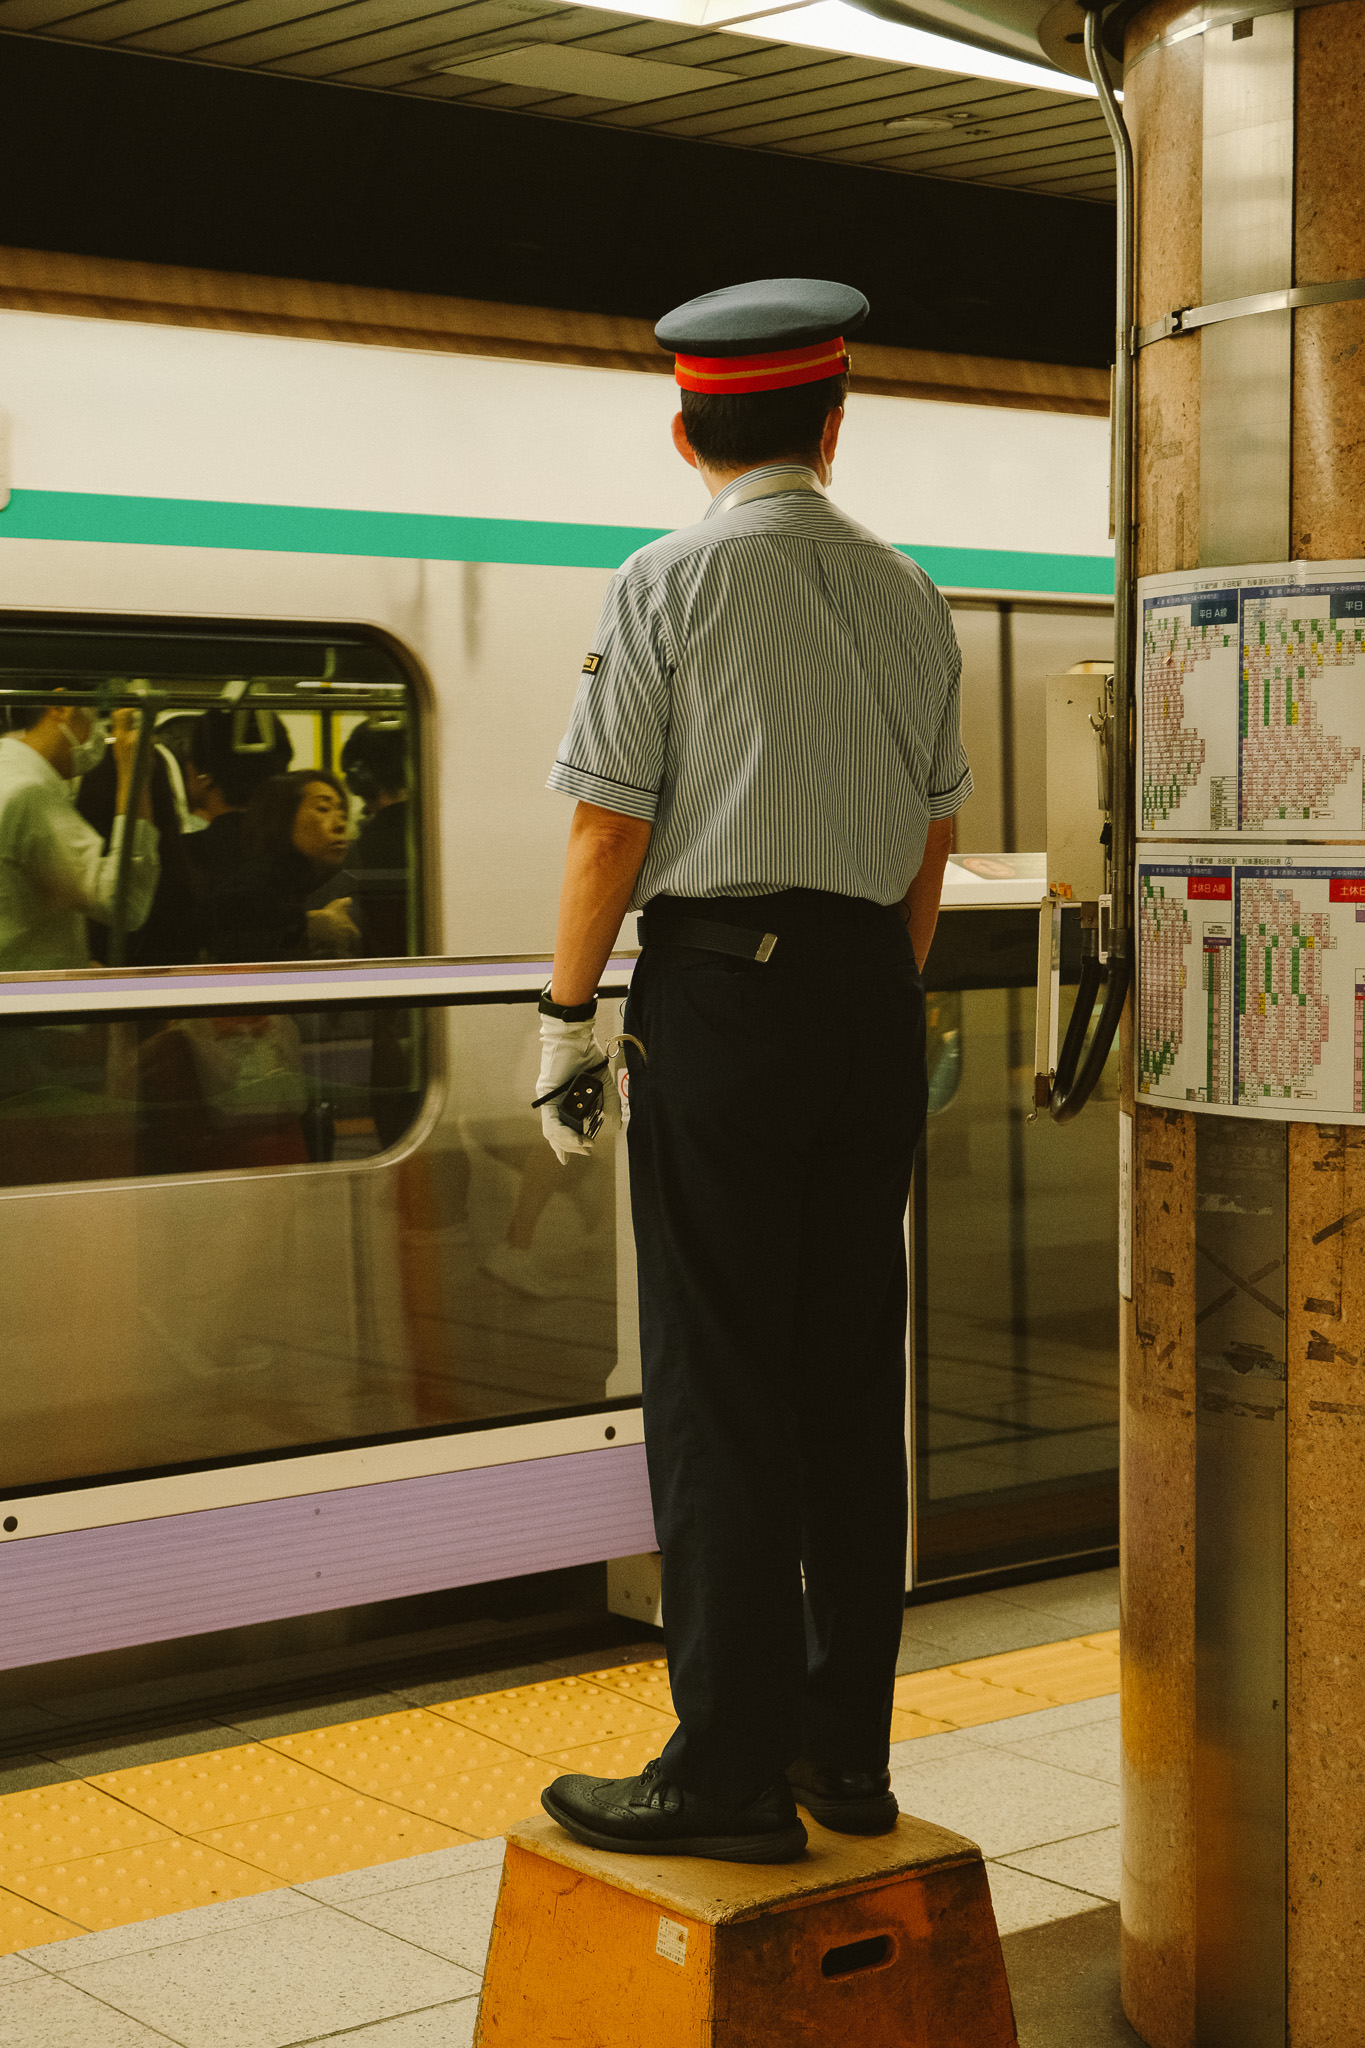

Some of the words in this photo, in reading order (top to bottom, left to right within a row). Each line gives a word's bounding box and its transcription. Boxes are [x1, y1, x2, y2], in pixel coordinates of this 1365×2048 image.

[1222, 579, 1242, 588] 永田町駅
[1345, 600, 1363, 611] 平日
[1199, 609, 1212, 619] 平日
[1214, 607, 1227, 617] A線
[1217, 857, 1237, 865] 永田町駅
[1192, 883, 1211, 893] 土休日
[1213, 884, 1226, 894] A線
